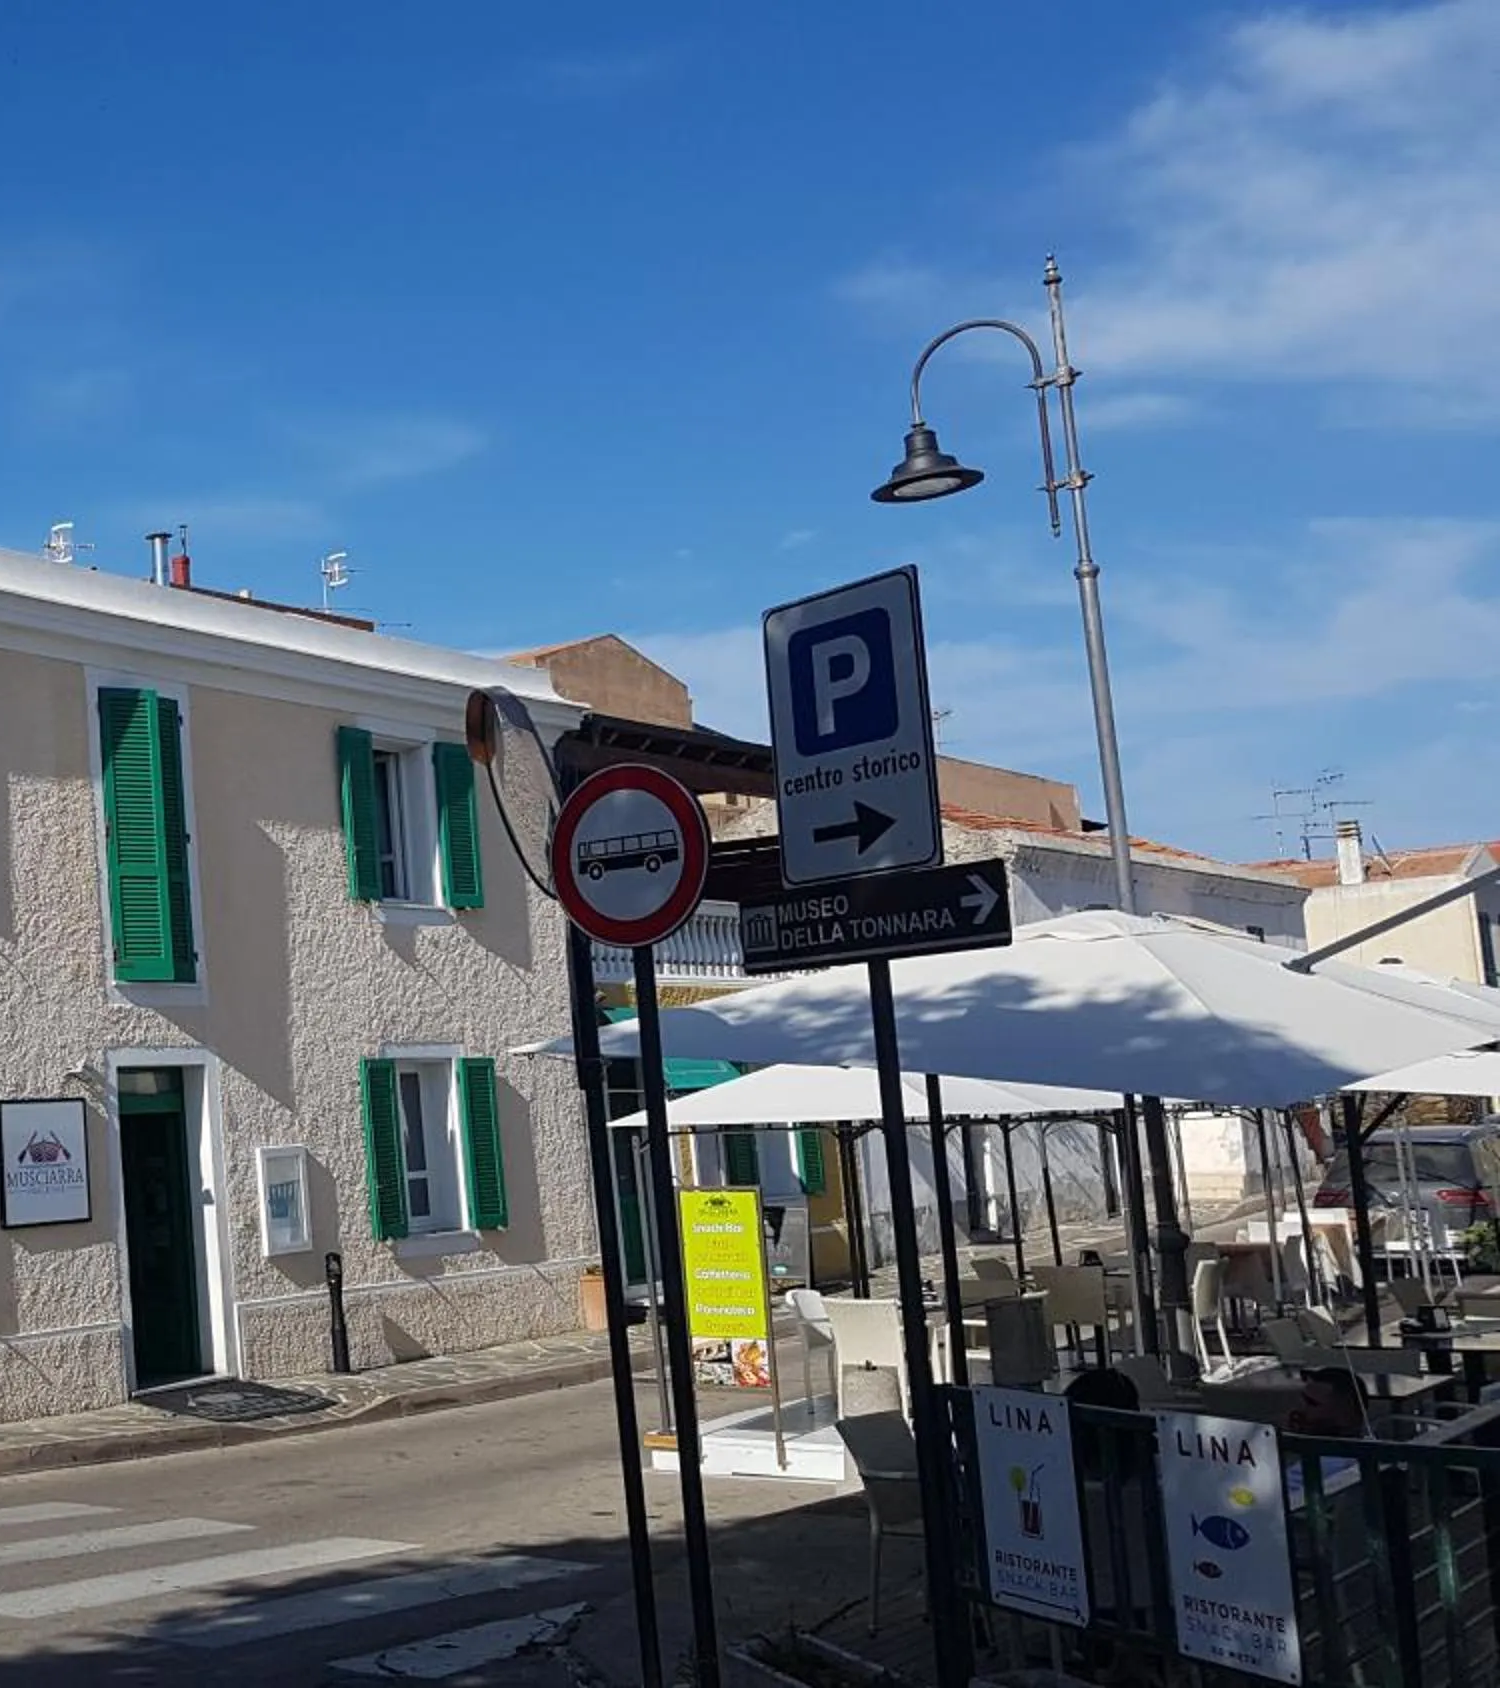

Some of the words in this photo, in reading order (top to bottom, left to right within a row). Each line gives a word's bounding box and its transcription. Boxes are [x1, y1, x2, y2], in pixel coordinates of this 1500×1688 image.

[811, 634, 871, 736] P
[784, 765, 843, 796] centro
[852, 750, 921, 782] storico
[777, 895, 849, 924] MUSEO
[780, 923, 845, 950] DELLA
[849, 907, 956, 939] TONNARA
[6, 1167, 85, 1189] MUSCIARRA
[989, 1402, 1053, 1434] LINA
[1176, 1429, 1257, 1467] LINA
[995, 1550, 1078, 1581] RISTORANTE
[997, 1569, 1043, 1590] SNACK
[1049, 1581, 1079, 1600] BAR
[1182, 1594, 1286, 1632] RISTORANTE
[1186, 1615, 1242, 1642] SNACK
[1252, 1633, 1287, 1654] BAR
